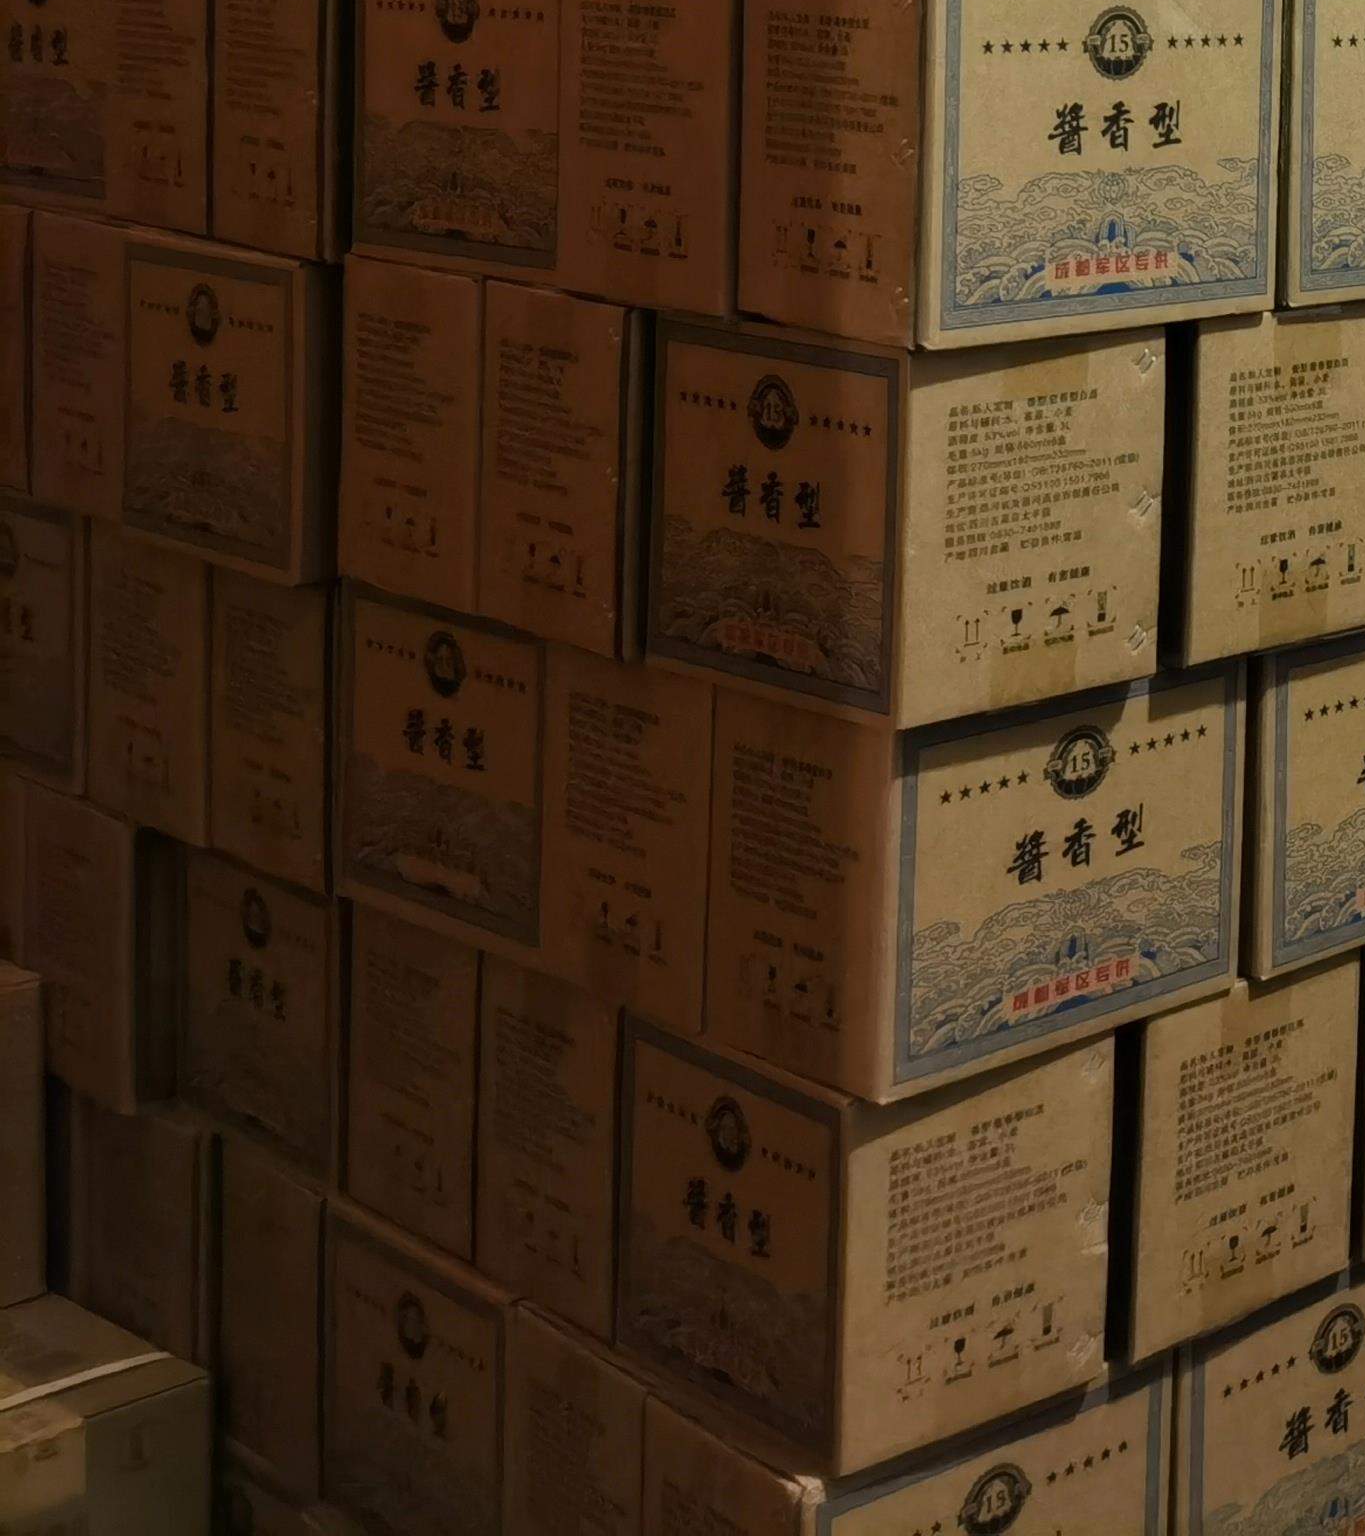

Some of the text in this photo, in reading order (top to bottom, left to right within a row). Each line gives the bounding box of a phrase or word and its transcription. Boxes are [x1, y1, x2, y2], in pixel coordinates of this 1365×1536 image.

[1108, 33, 1129, 53] 15
[1046, 97, 1183, 158] 醬香型
[1054, 251, 1170, 280] 成都军区专供
[1070, 750, 1091, 774] 15
[1005, 800, 1146, 891] 醬香型
